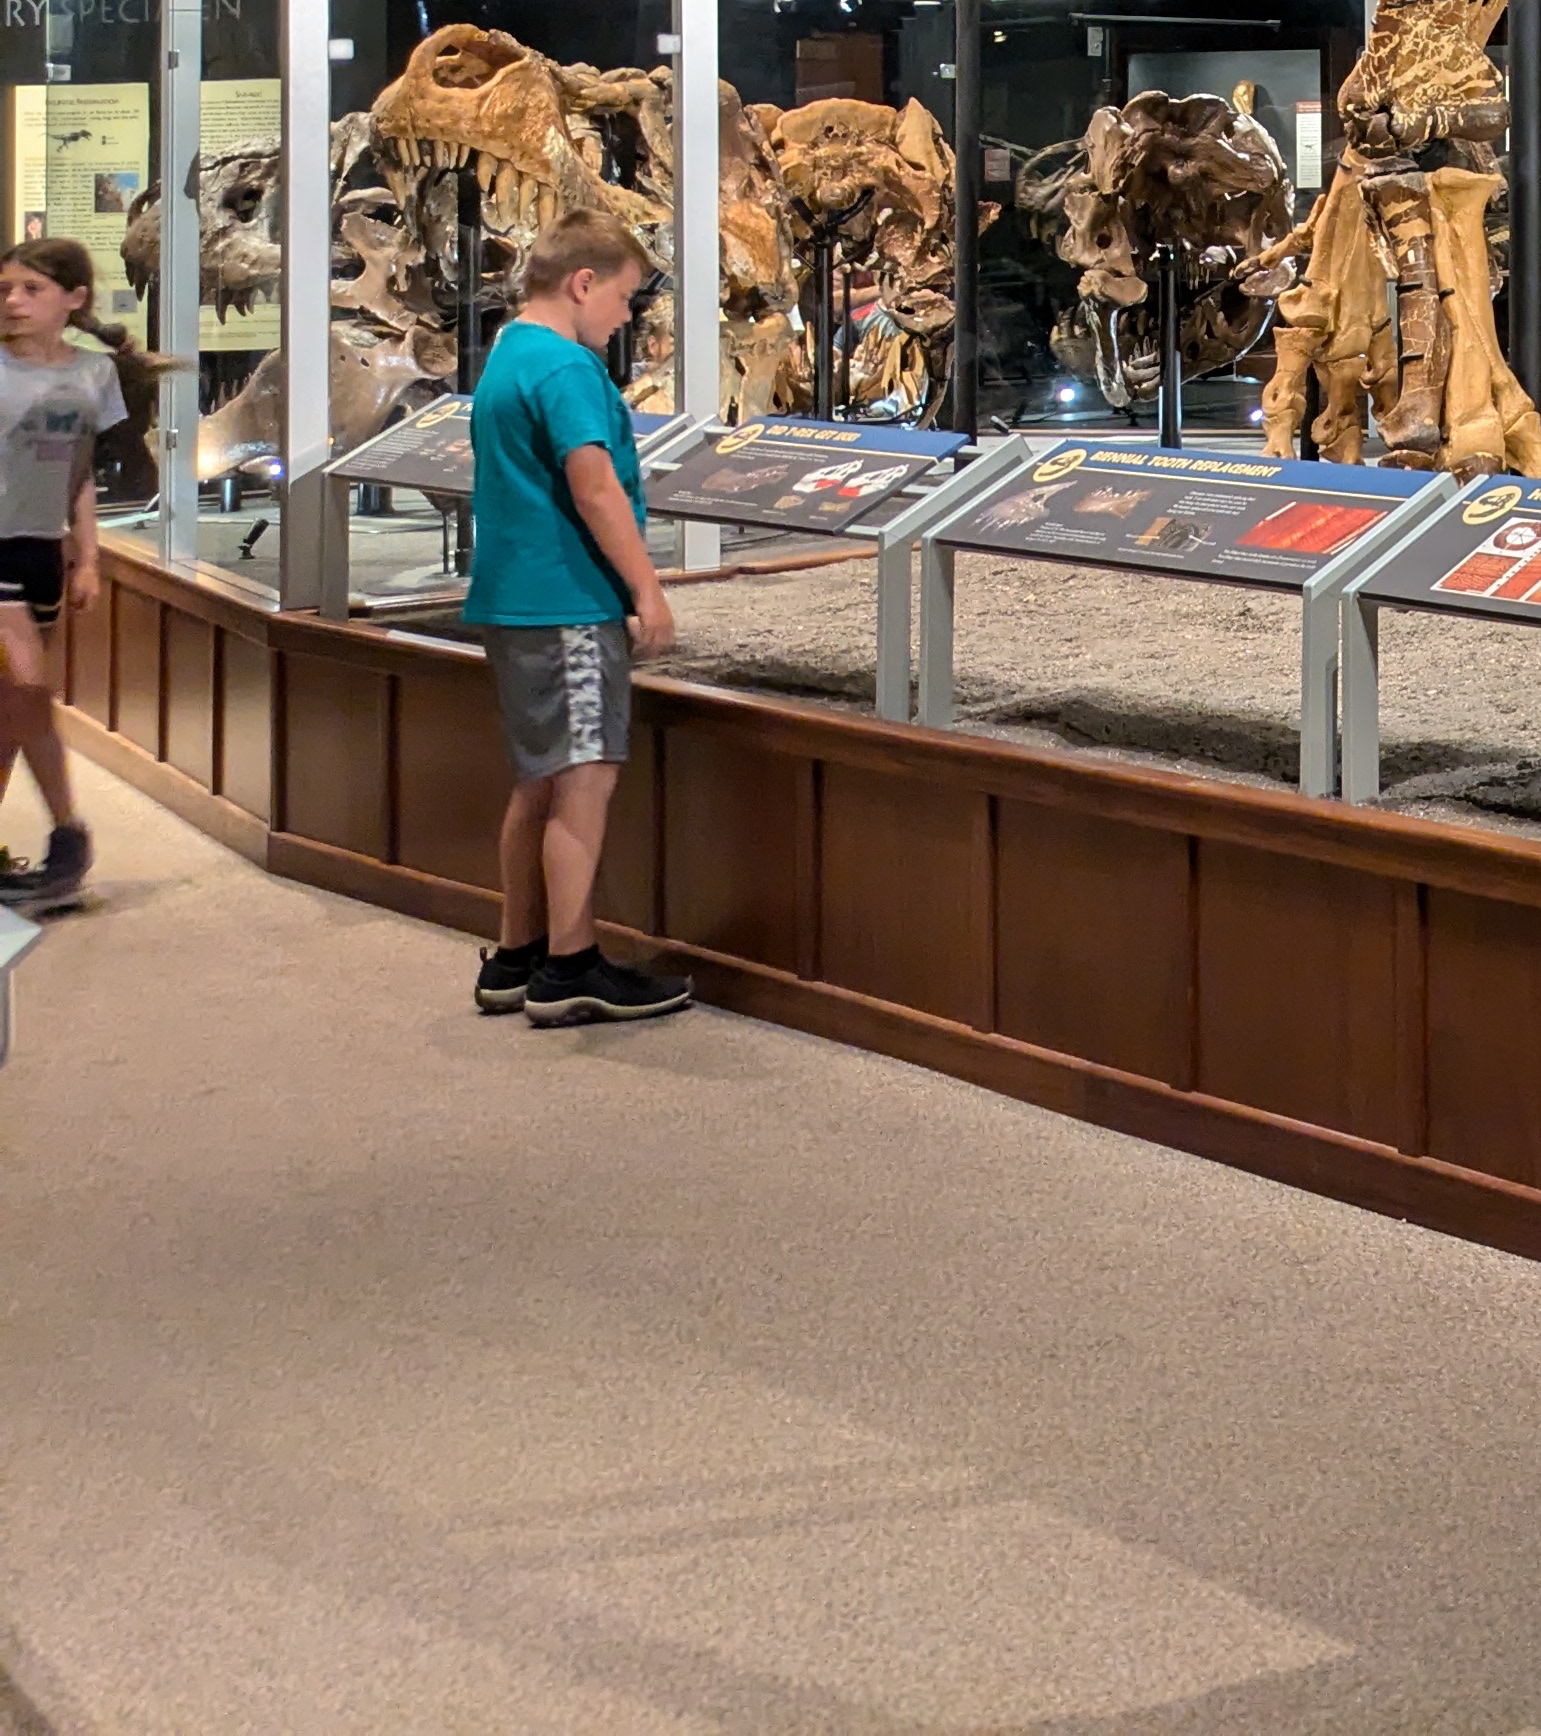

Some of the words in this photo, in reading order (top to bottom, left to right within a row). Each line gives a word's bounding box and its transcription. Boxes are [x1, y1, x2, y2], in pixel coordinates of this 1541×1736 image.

[1090, 450, 1149, 465] BIENNIAL
[1147, 455, 1193, 470] TOOTH
[1189, 459, 1282, 477] REPLACEMENT
